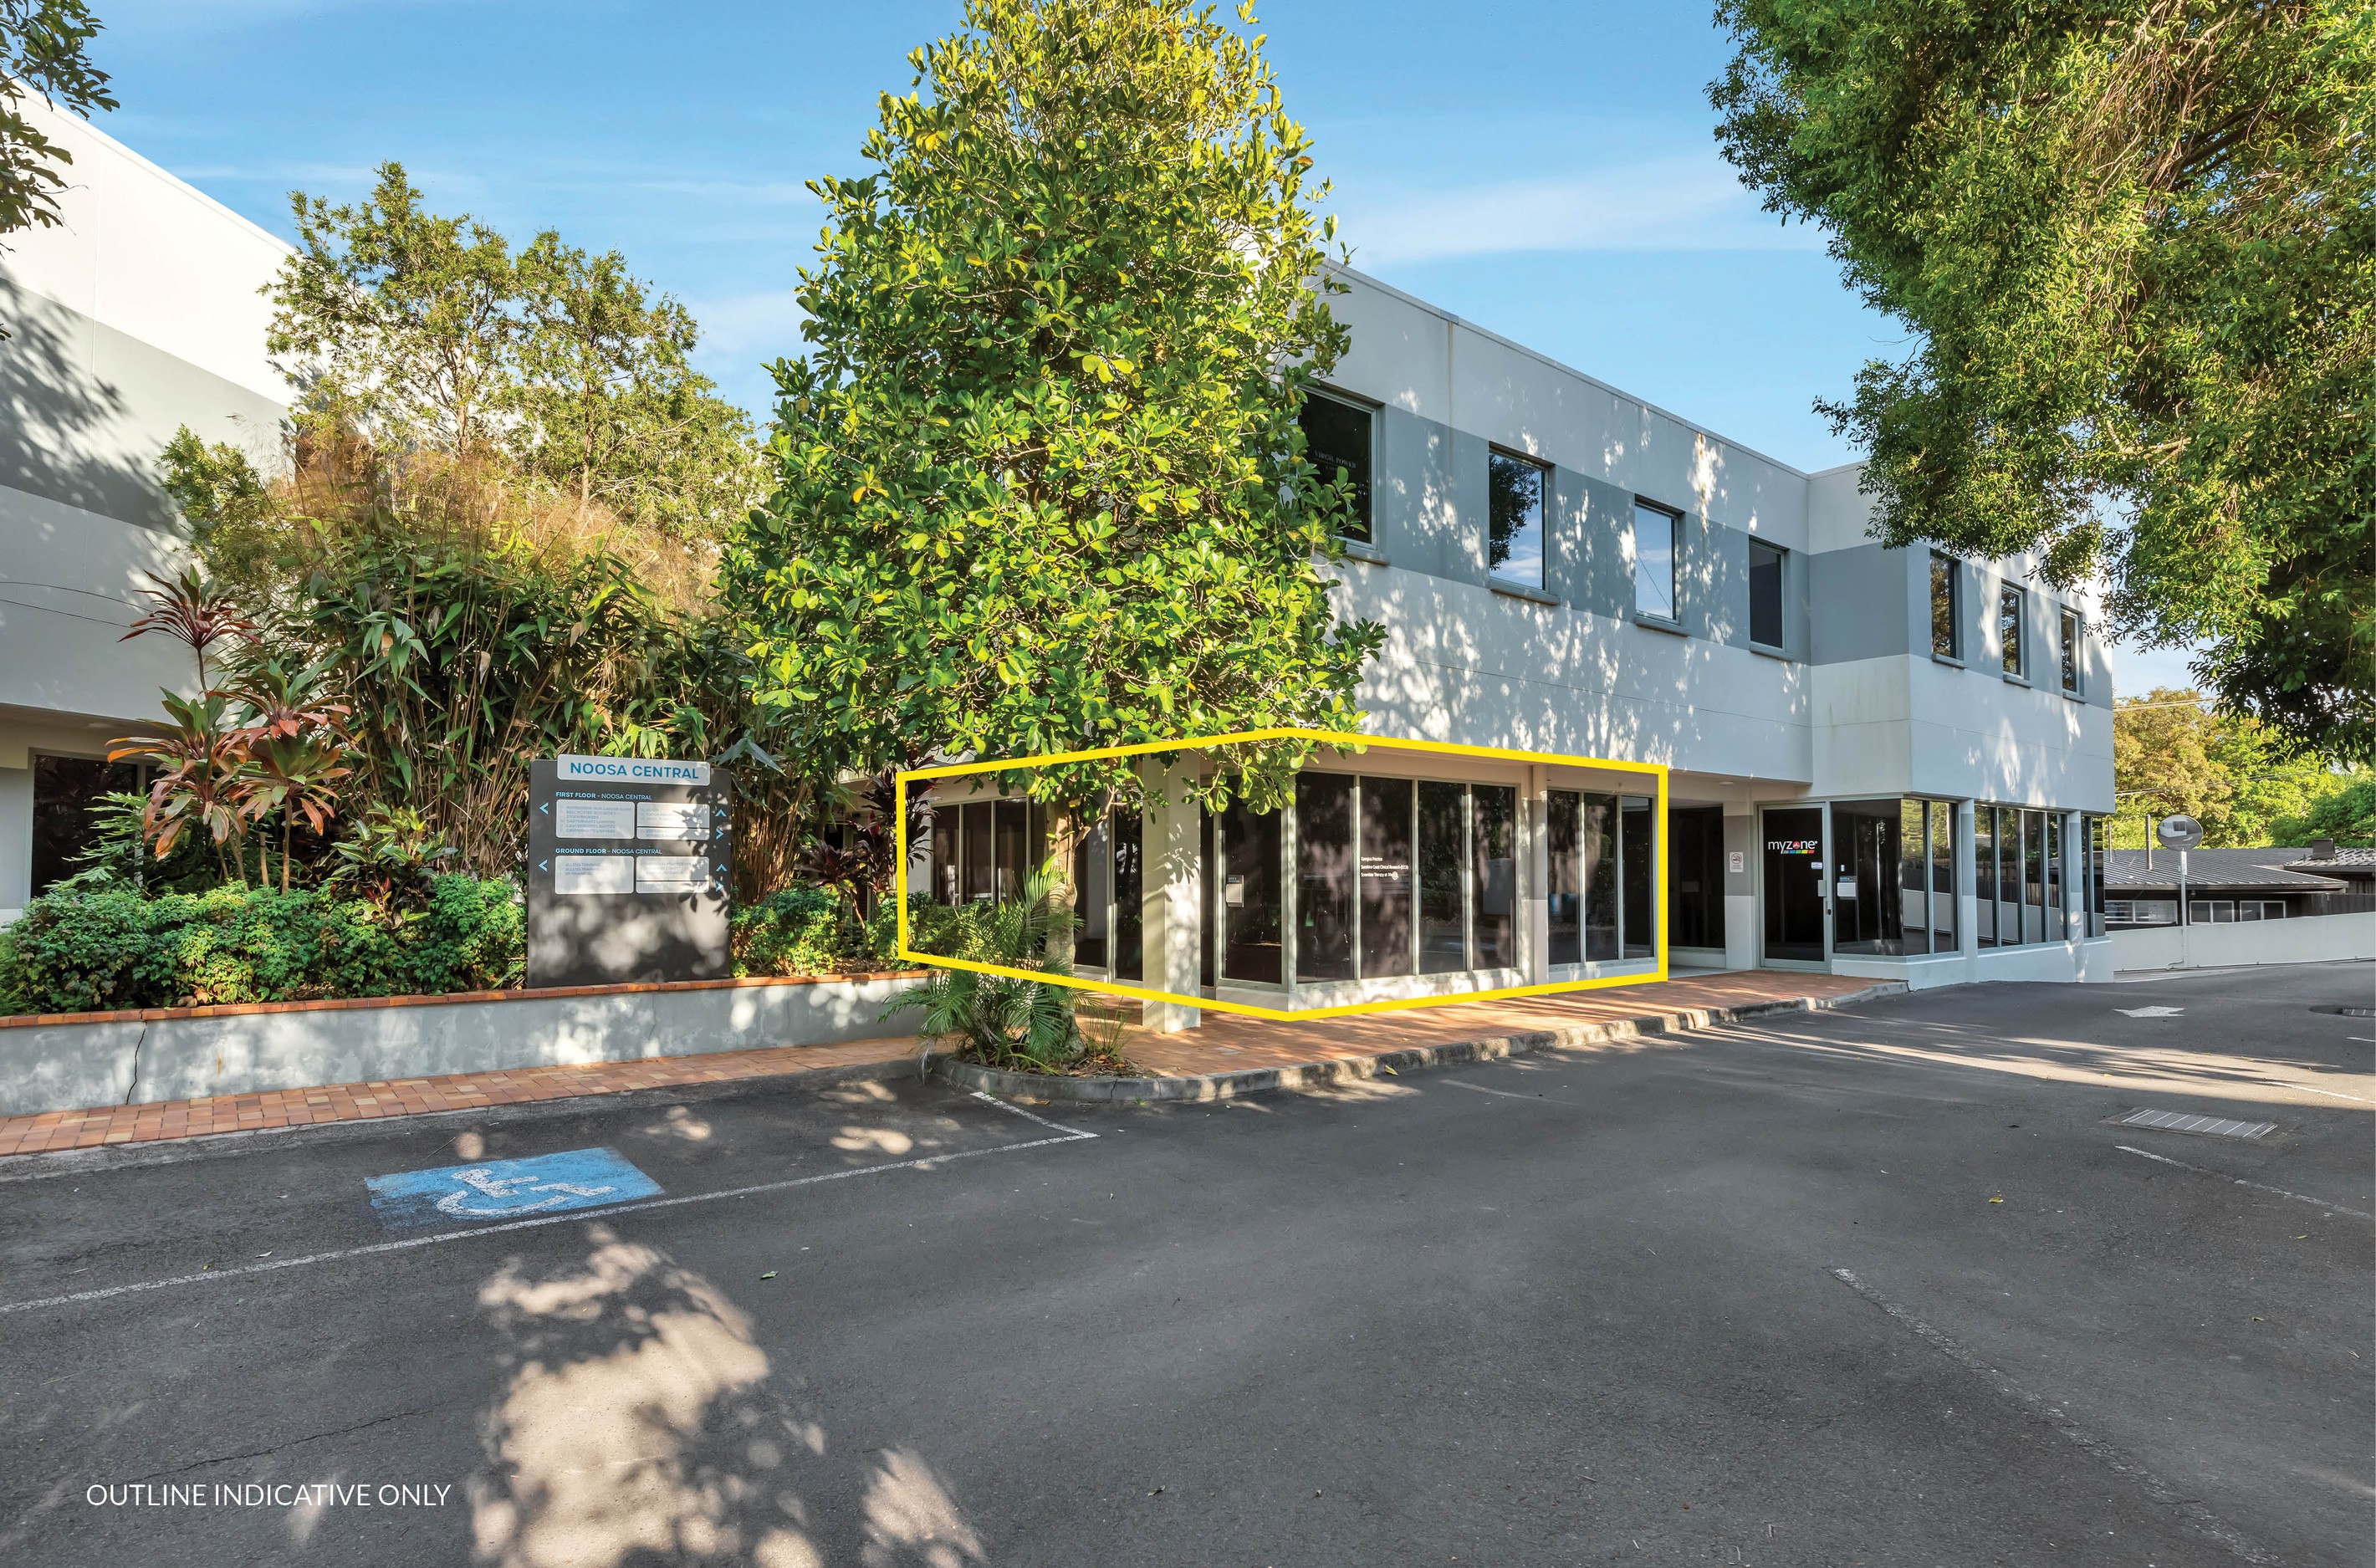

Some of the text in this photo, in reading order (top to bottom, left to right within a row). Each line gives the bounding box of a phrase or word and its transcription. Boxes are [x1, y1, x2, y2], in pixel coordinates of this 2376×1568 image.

[1315, 450, 1335, 462] VIRGIL
[570, 762, 699, 779] NOOSA CENTRAL
[1768, 840, 1816, 854] myzone
